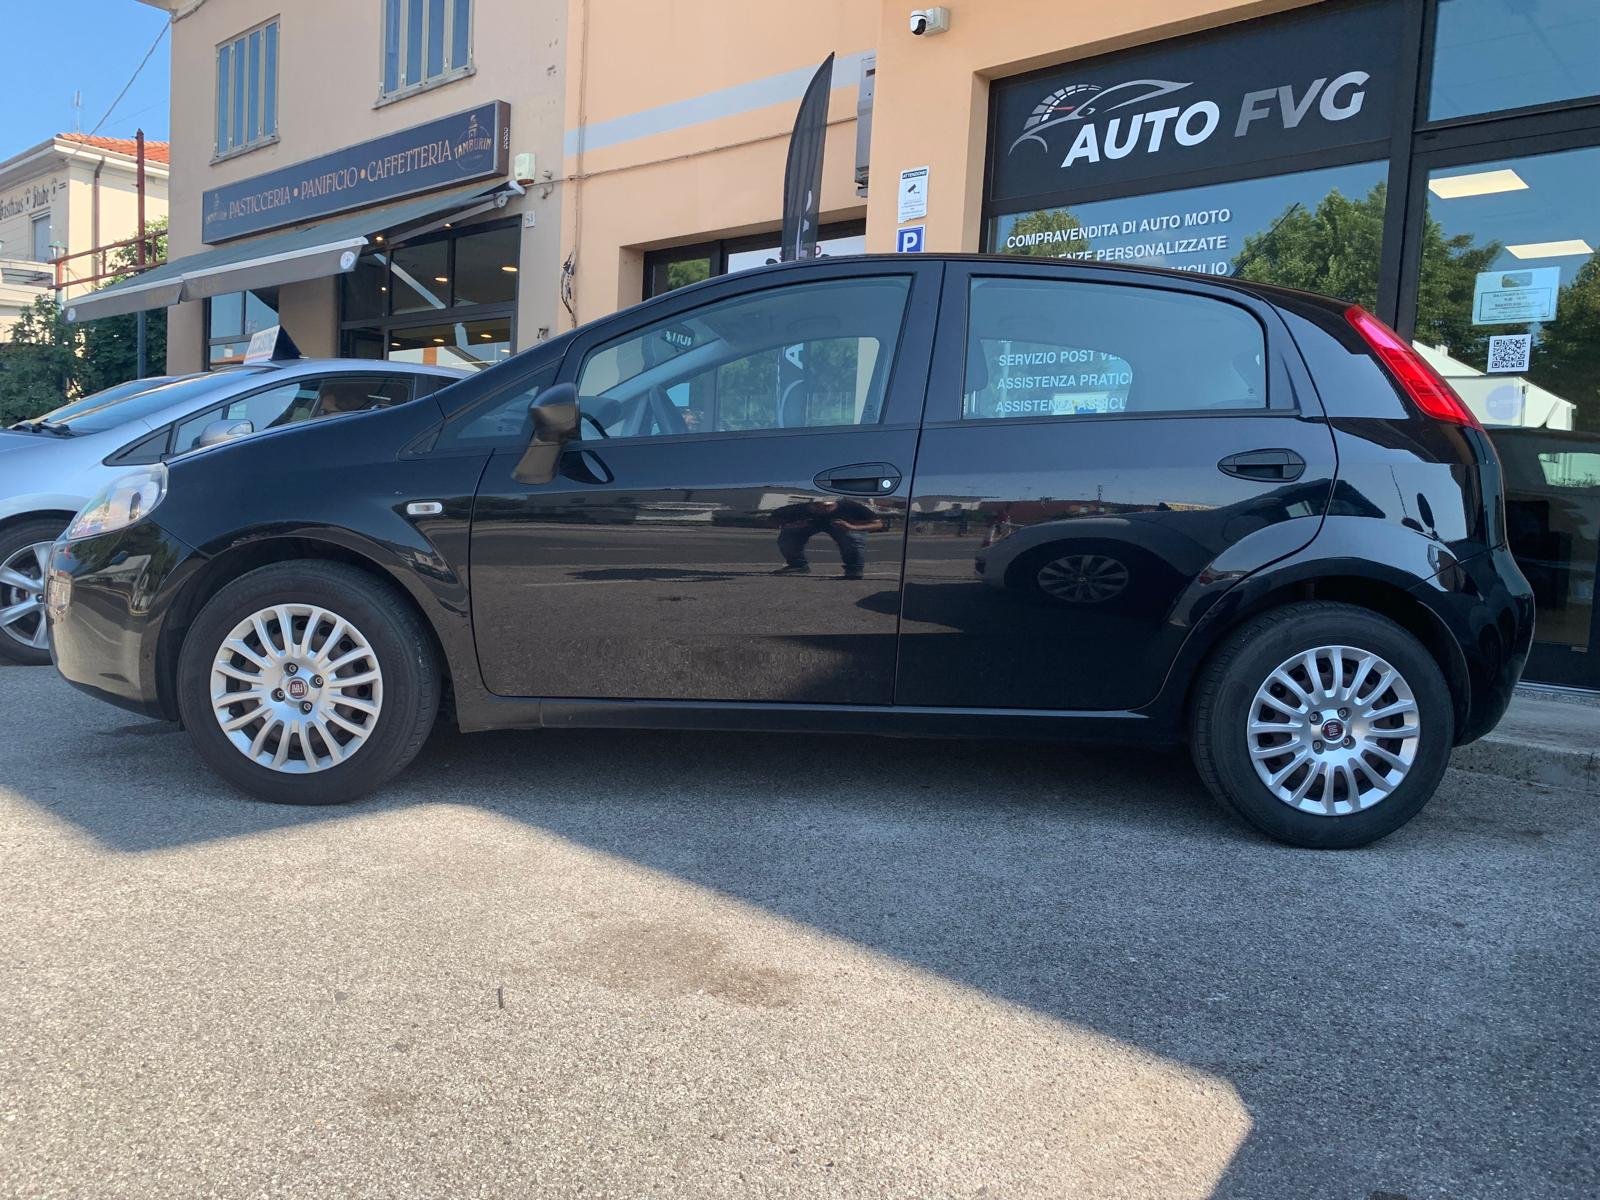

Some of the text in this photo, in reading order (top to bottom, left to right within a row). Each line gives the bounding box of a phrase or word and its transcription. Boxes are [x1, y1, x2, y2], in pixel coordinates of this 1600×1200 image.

[1061, 70, 1370, 168] AUTO FVG
[229, 186, 291, 219] PASTICCERIA
[301, 167, 358, 200] PANIFICIO
[367, 140, 452, 182] CAFFETTERIA
[1006, 208, 1231, 249] COMPRAVENDITA DI AUTO MOTO
[903, 232, 918, 253] P
[1096, 235, 1227, 261] PERSONALIZZATE
[998, 351, 1057, 367] SERVIZIO
[1059, 349, 1095, 363] POST
[996, 374, 1077, 390] ASSISTENZA
[995, 399, 1075, 413] ASSISTENZA
